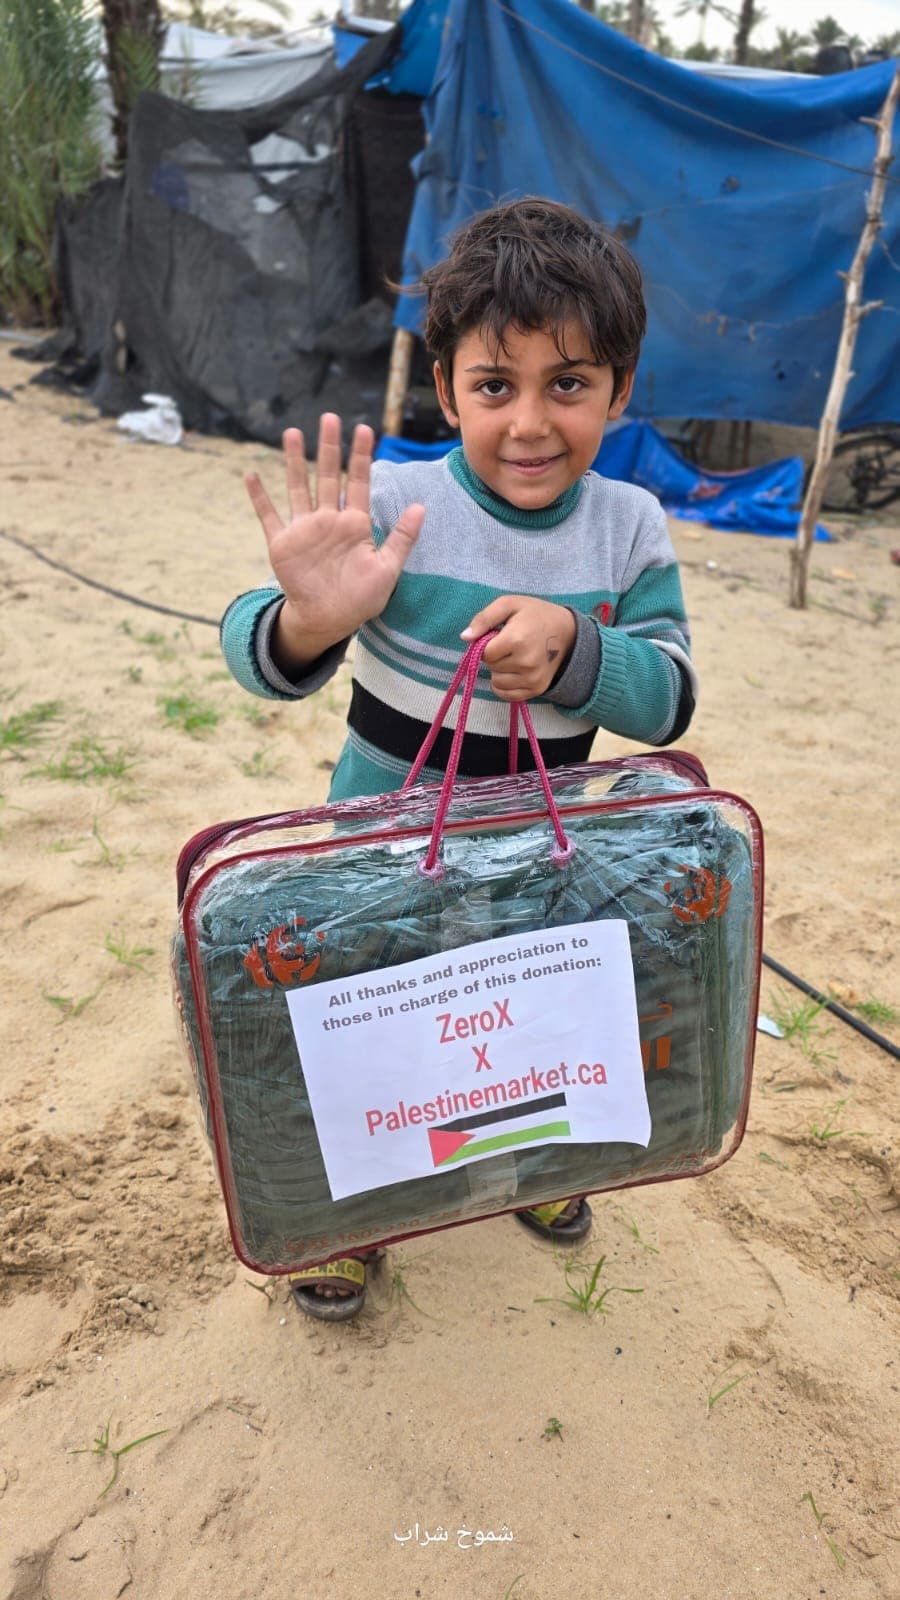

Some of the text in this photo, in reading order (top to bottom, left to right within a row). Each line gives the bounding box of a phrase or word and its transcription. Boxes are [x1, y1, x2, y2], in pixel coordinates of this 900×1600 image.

[321, 956, 602, 1032] those in charge of this donation:
[328, 936, 589, 1008] All thanks and appreciation to
[435, 998, 515, 1044] ZeroX
[471, 1042, 493, 1073] X
[365, 1061, 608, 1137] Palestinemarket.ca
